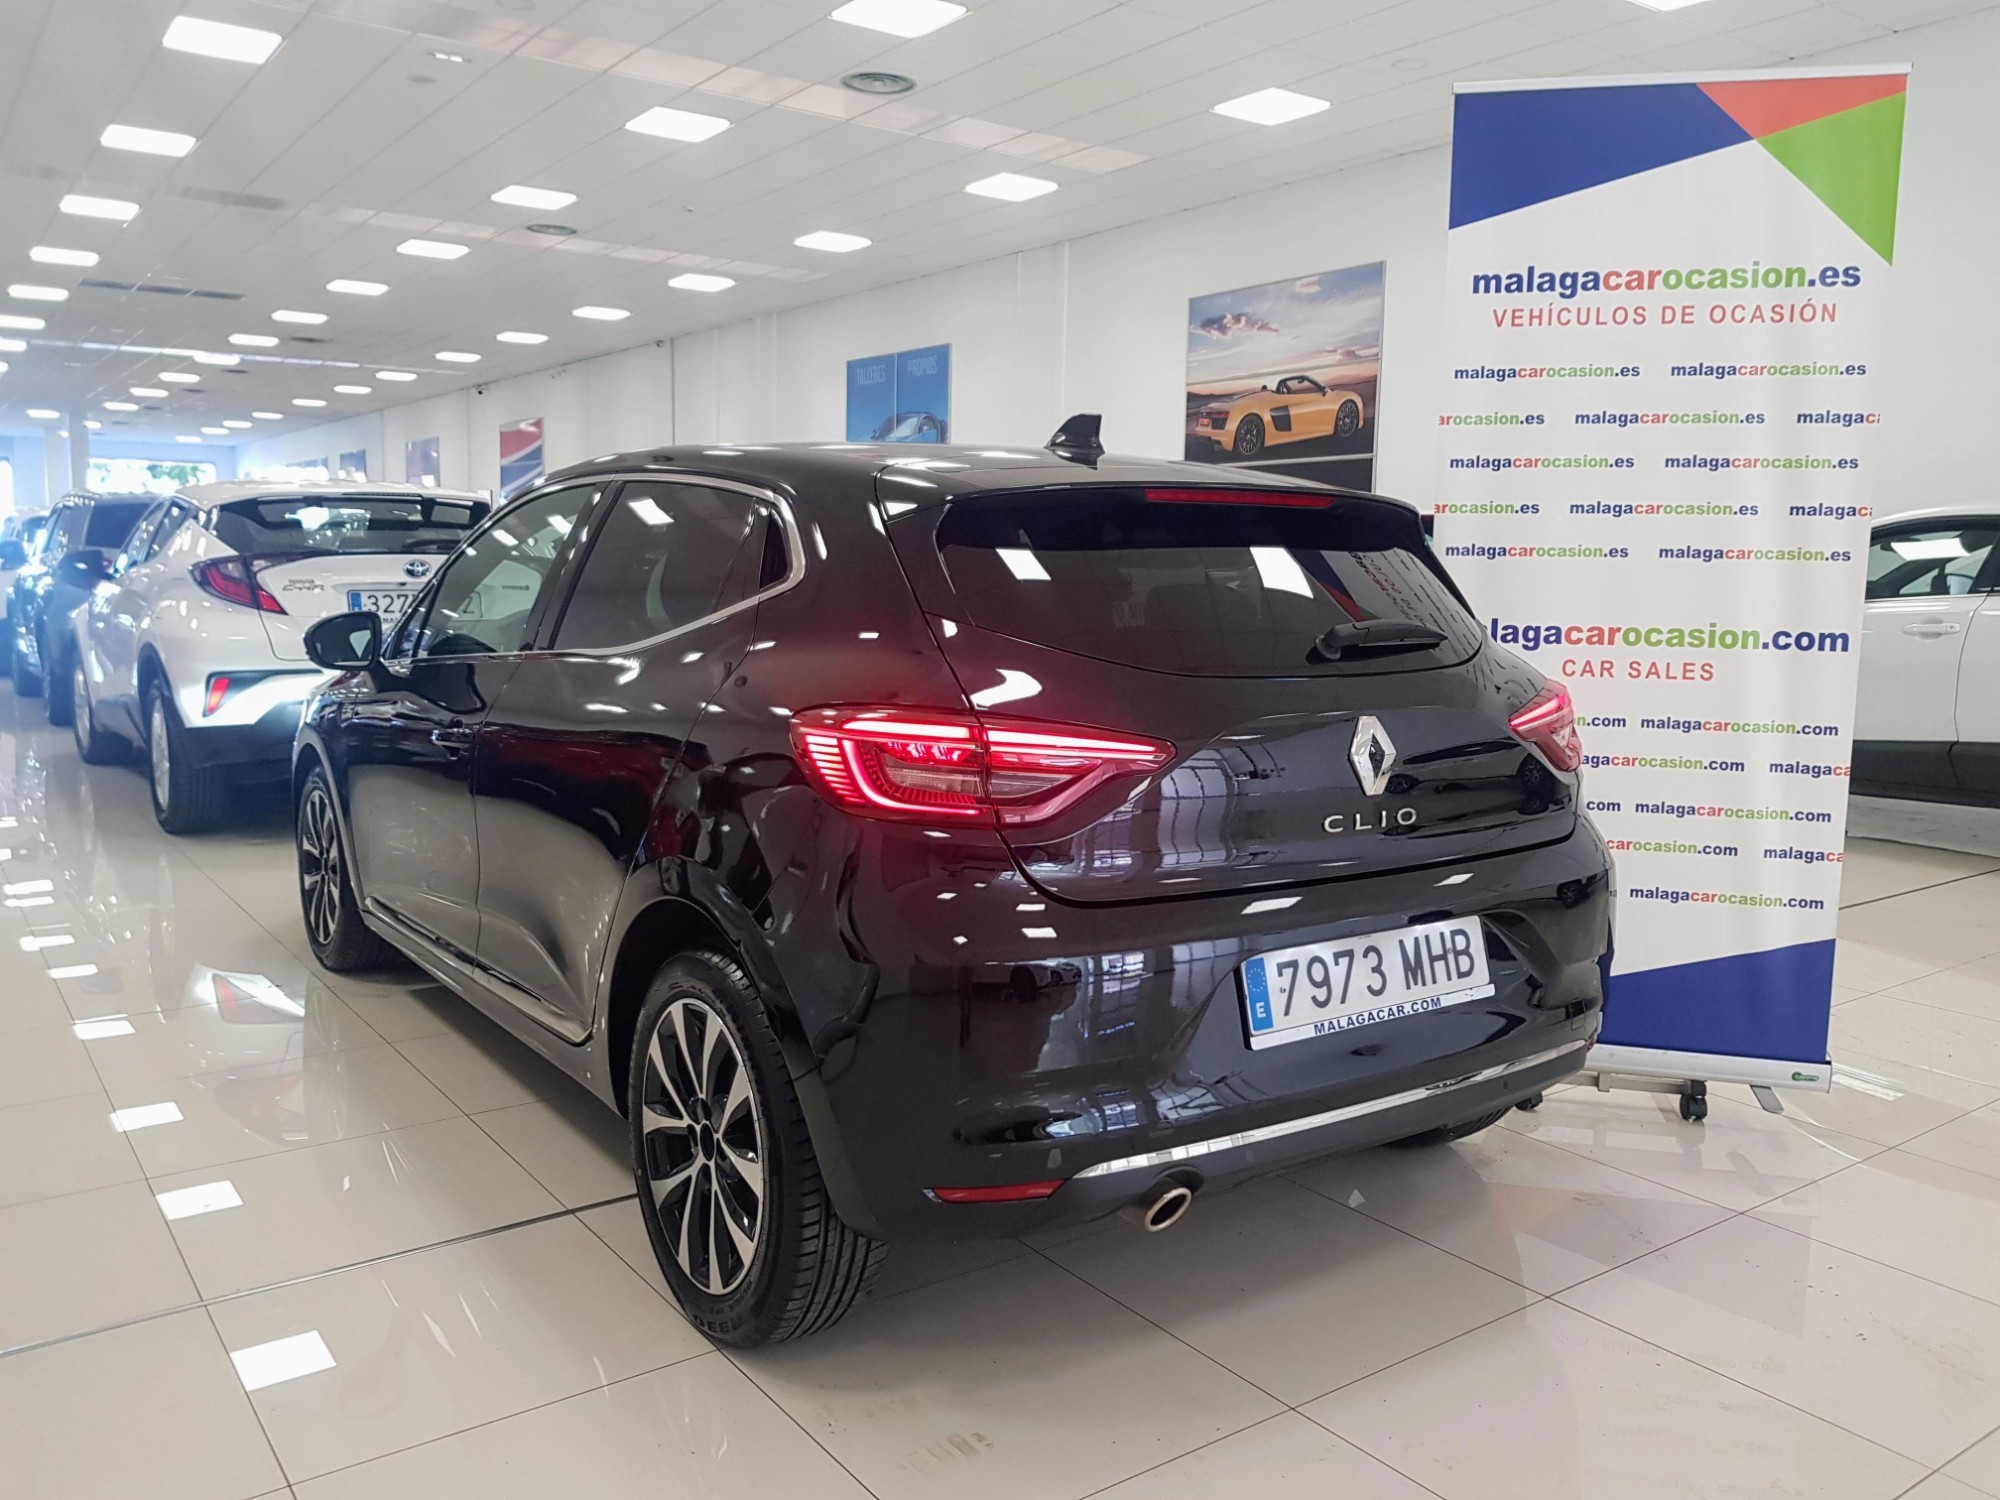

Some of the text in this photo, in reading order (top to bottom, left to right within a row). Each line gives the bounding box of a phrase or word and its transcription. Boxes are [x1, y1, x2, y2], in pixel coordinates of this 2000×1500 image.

[1472, 261, 1860, 298] malagacarocasion.es
[1493, 298, 1837, 327] VEHÍCULOS DE OCASIÓN
[1454, 363, 1640, 382] malagacarocasion.es
[1670, 361, 1866, 379] malagacarocasion.es
[1574, 410, 1765, 427] malagacarocasion.es
[1796, 409, 1880, 427] malagac
[1449, 454, 1634, 471] malagacarocasion.es
[1664, 454, 1858, 471] malagacarocasion.es
[1569, 500, 1758, 517] malagacarocasion.es
[1788, 502, 1872, 520] malagac
[1445, 543, 1628, 560] malagacarocasion.es
[1658, 545, 1851, 562] malagacarocasion.es
[367, 594, 417, 614] 327
[1490, 618, 1849, 652] lagacarocasion.com
[1561, 658, 1713, 681] CAR SALES
[1640, 716, 1838, 736] malagacarocasion.com
[1323, 808, 1417, 833] CLIO
[1635, 800, 1831, 822] malagacarocasion.com
[1606, 840, 1738, 857] carocasion.com
[1629, 886, 1824, 909] malagacarocasion.com
[1276, 928, 1476, 1018] 7973 MHB
[1255, 1001, 1267, 1019] E
[1313, 996, 1443, 1036] MALAGACAR.COM
